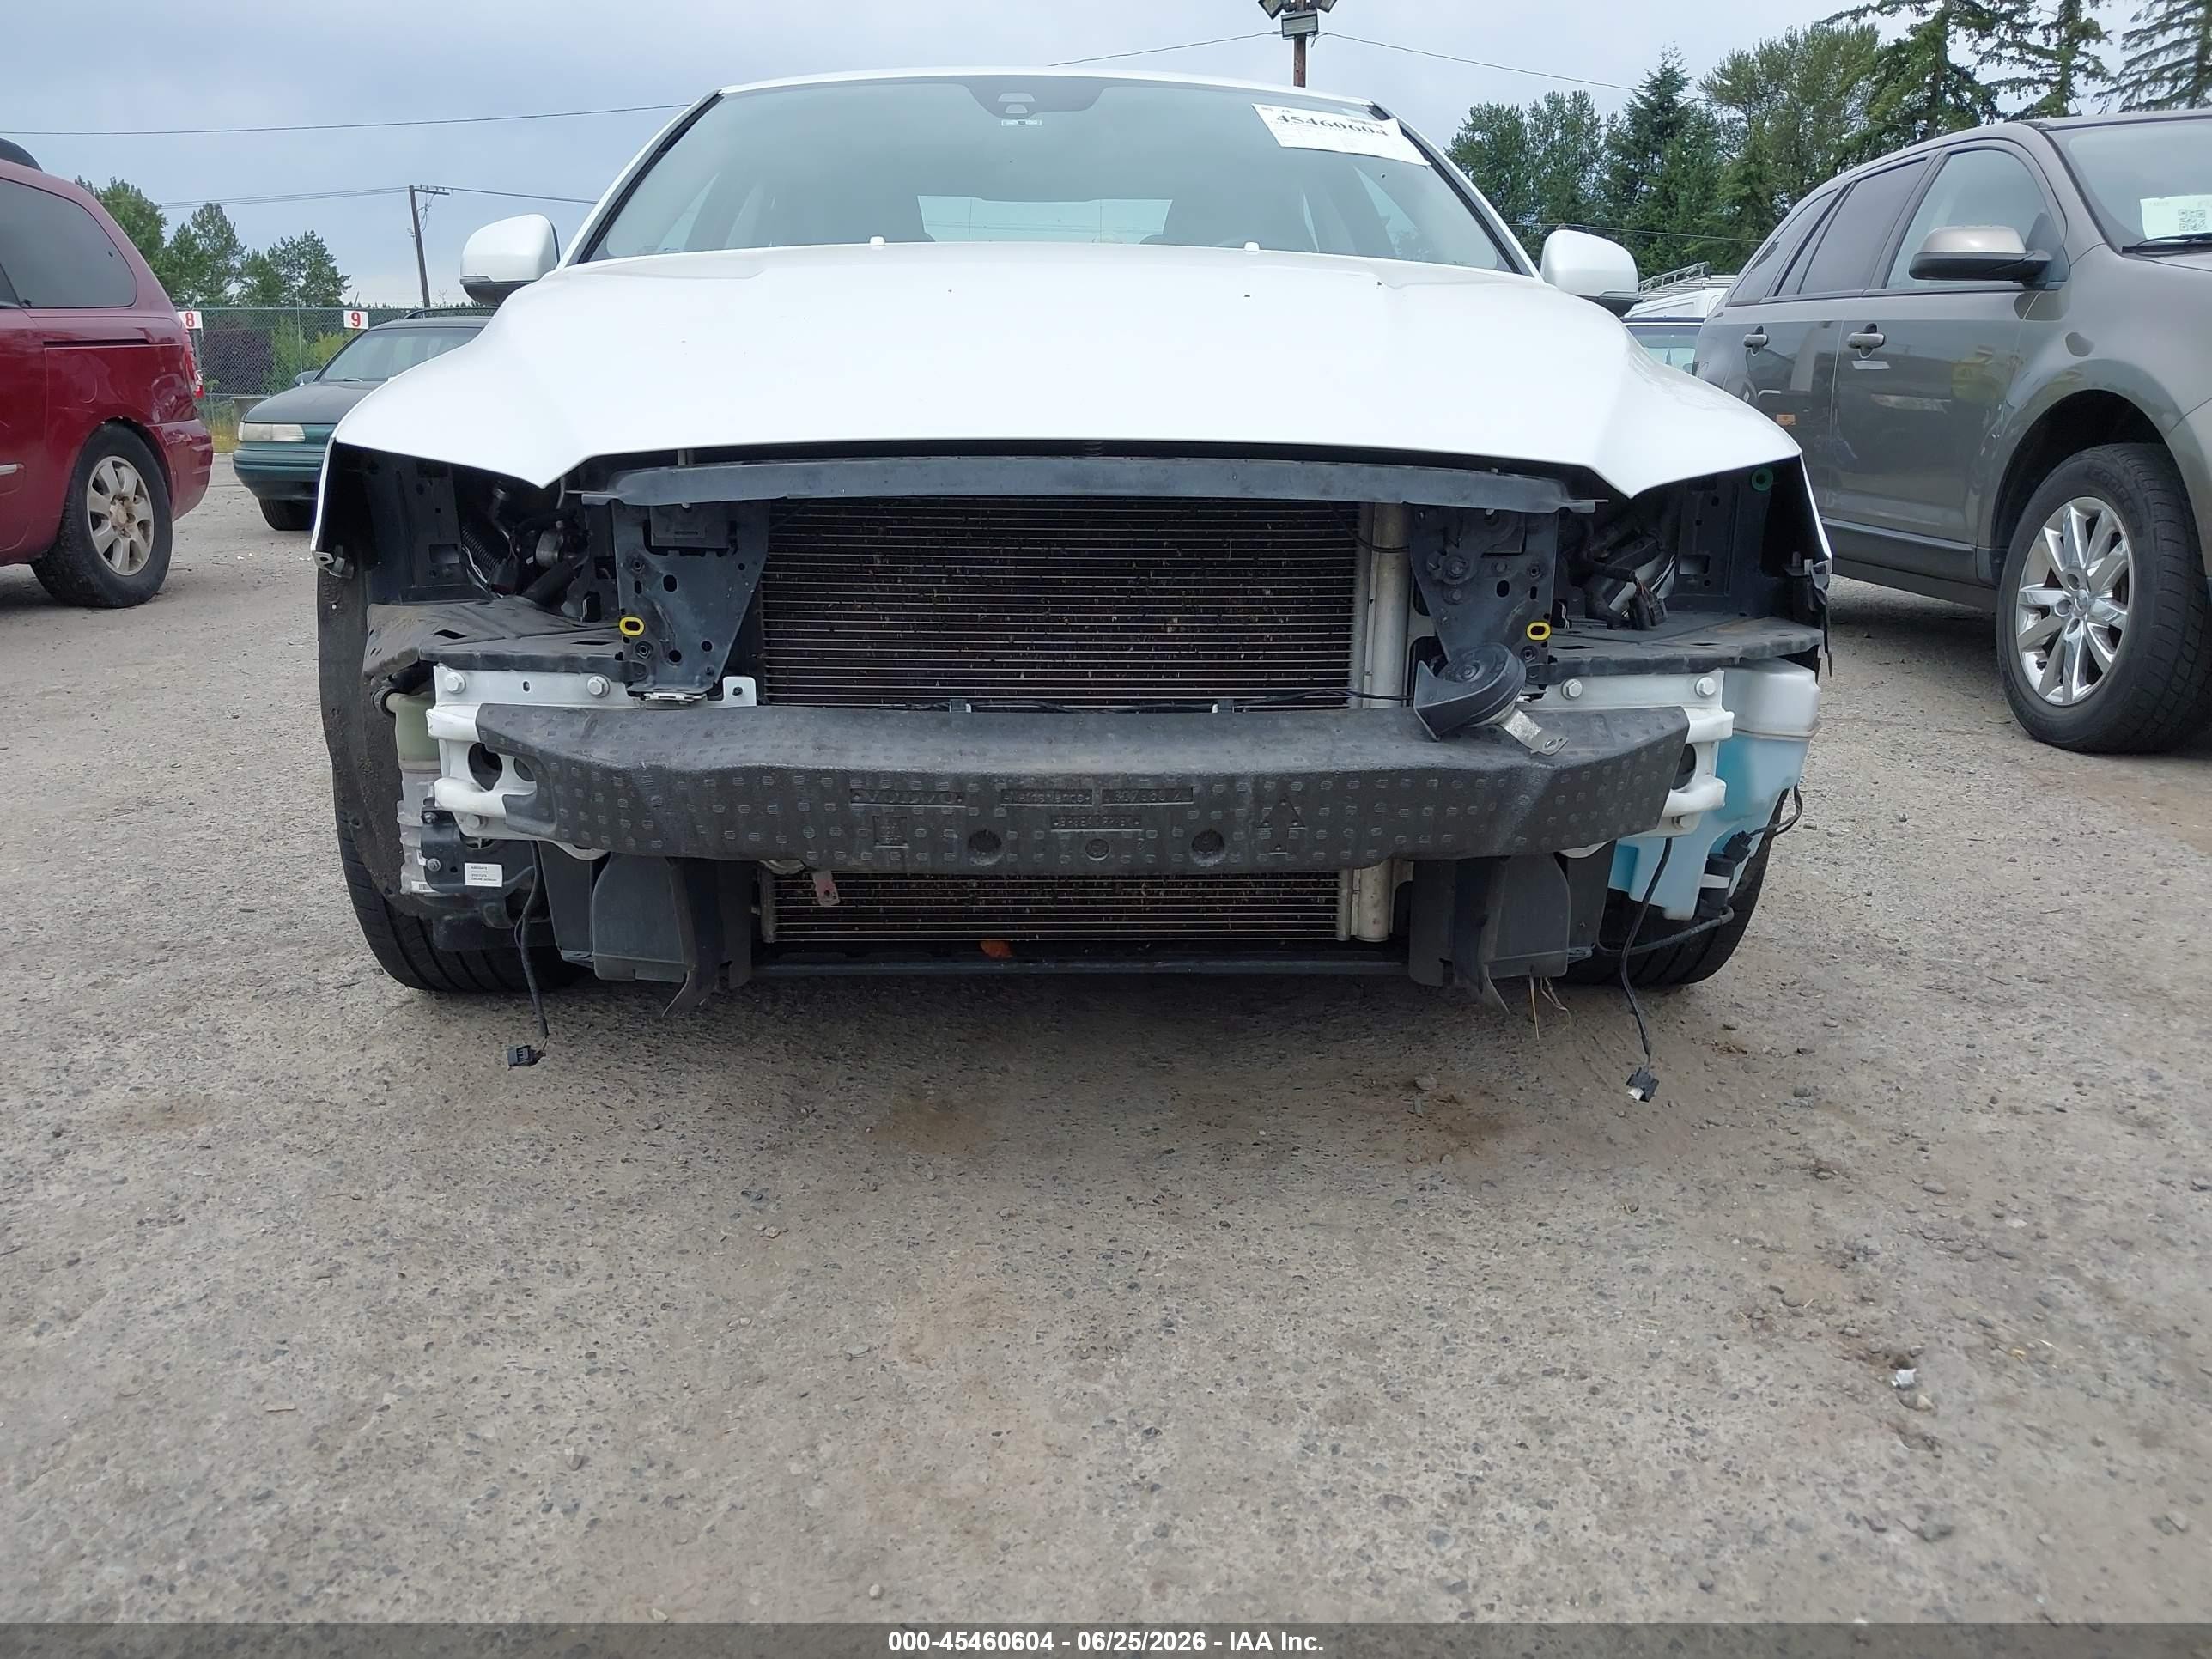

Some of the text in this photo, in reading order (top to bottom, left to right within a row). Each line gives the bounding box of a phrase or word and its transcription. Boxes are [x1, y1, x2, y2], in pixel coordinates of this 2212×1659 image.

[1276, 115, 1389, 136] 45460604
[185, 312, 195, 327] 8
[350, 312, 362, 327] 9
